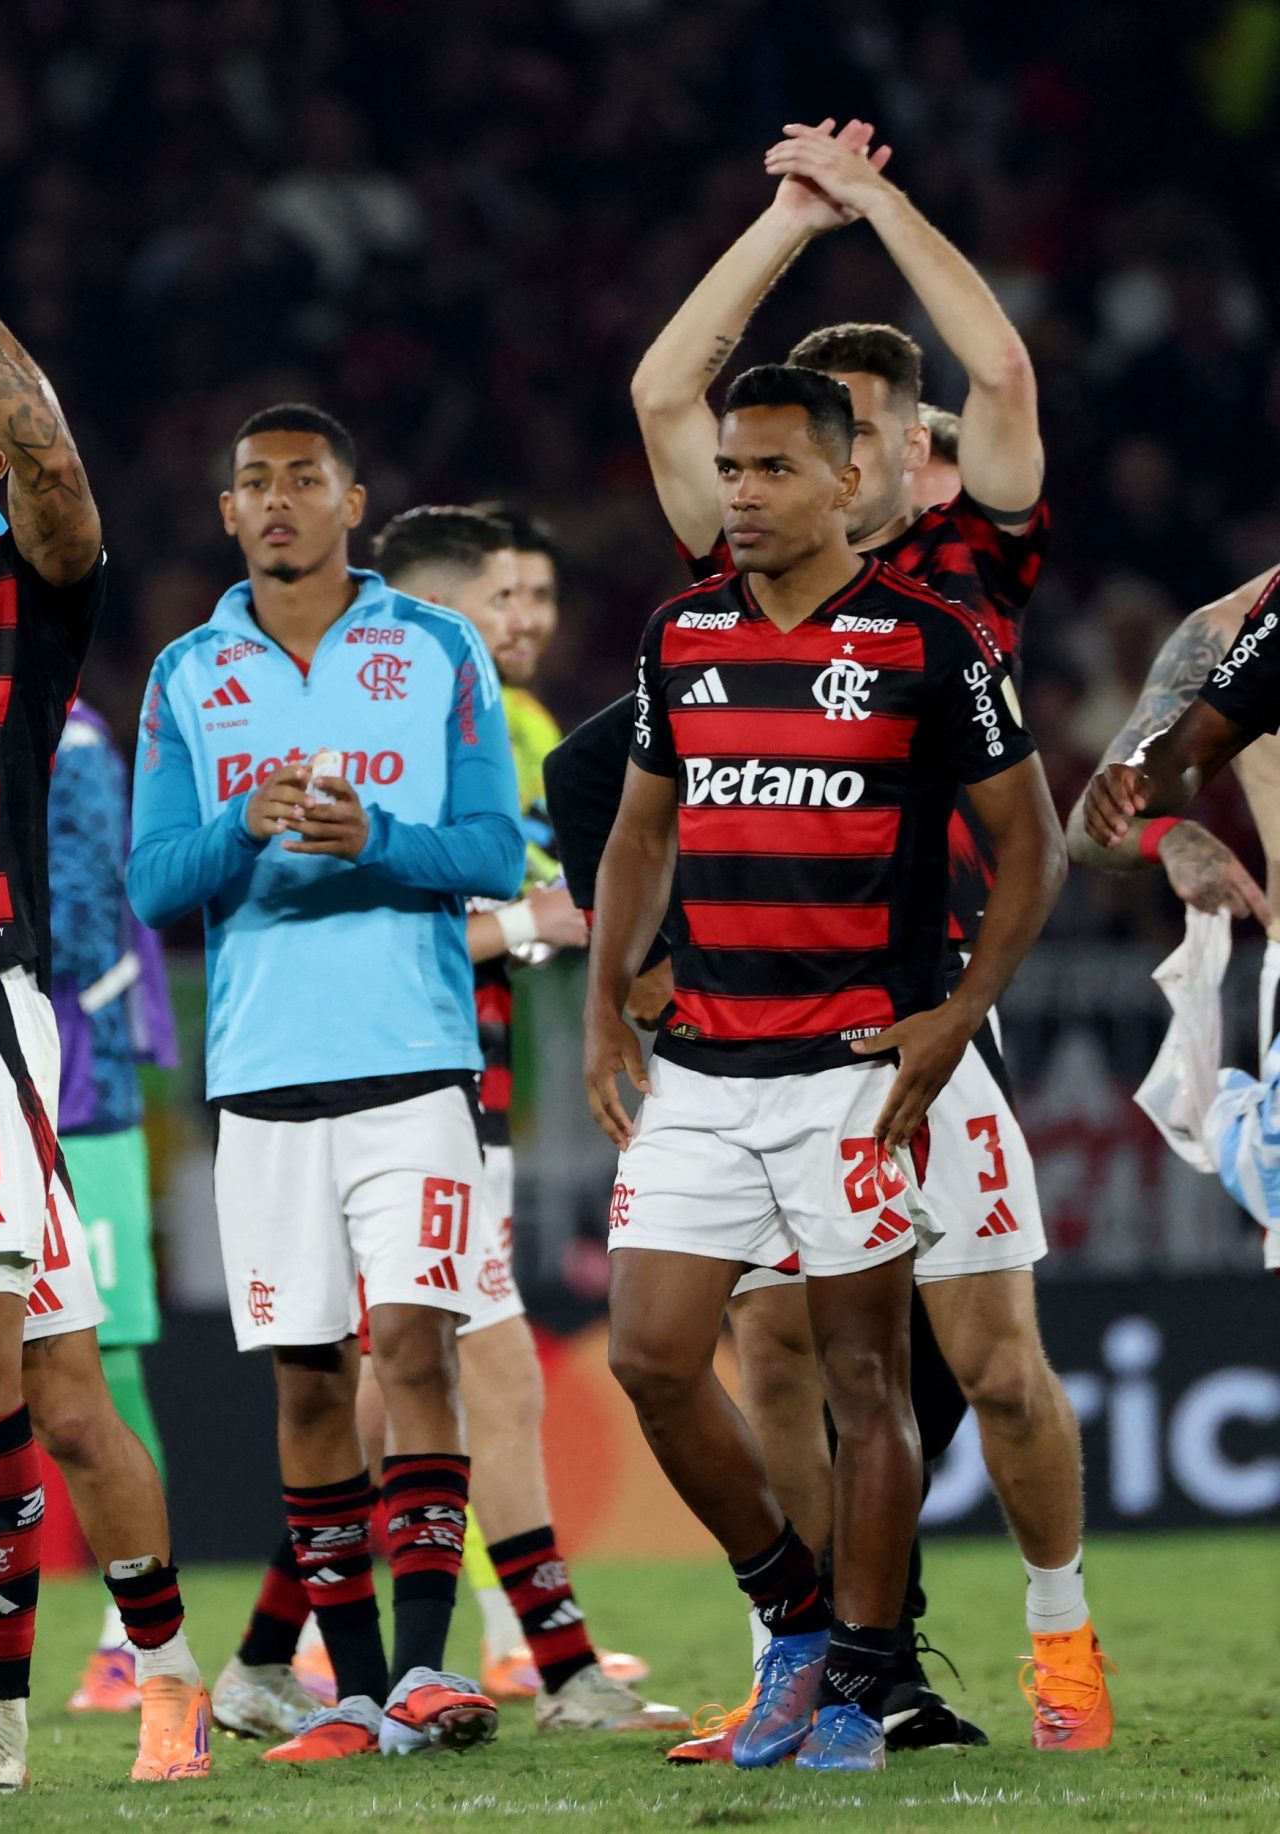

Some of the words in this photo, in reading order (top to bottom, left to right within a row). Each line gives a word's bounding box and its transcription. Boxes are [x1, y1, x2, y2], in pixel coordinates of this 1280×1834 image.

[366, 628, 405, 644] BRB
[697, 612, 739, 630] BRB
[852, 617, 897, 634] BRB
[217, 747, 404, 802] Betno
[684, 758, 864, 808] Betano
[966, 1114, 1008, 1193] 3
[418, 1177, 471, 1255] 61
